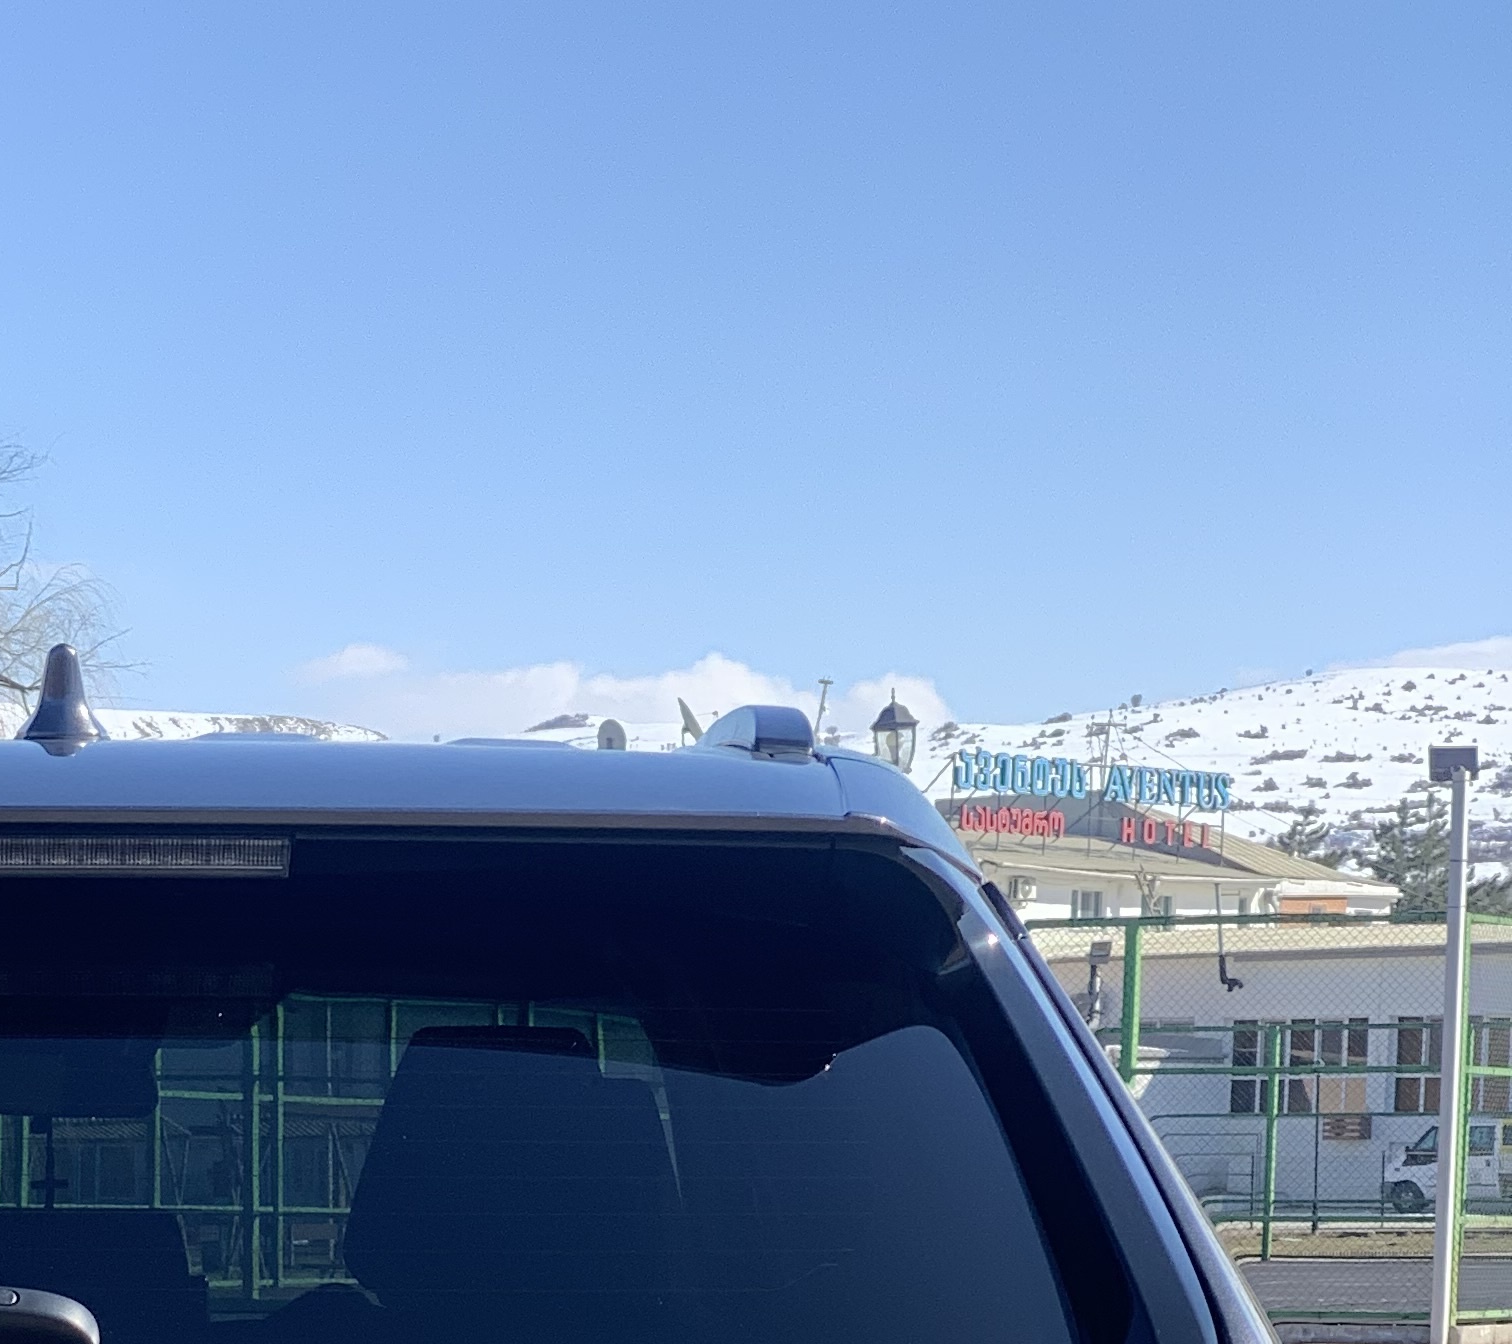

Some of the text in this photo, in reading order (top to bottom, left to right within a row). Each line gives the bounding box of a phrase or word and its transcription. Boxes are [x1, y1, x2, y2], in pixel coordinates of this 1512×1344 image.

[954, 746, 1086, 800] ავენტუს
[1104, 764, 1232, 811] AVENTUS
[961, 804, 1066, 839] სასტუმრო
[1121, 816, 1213, 849] HOTEL
